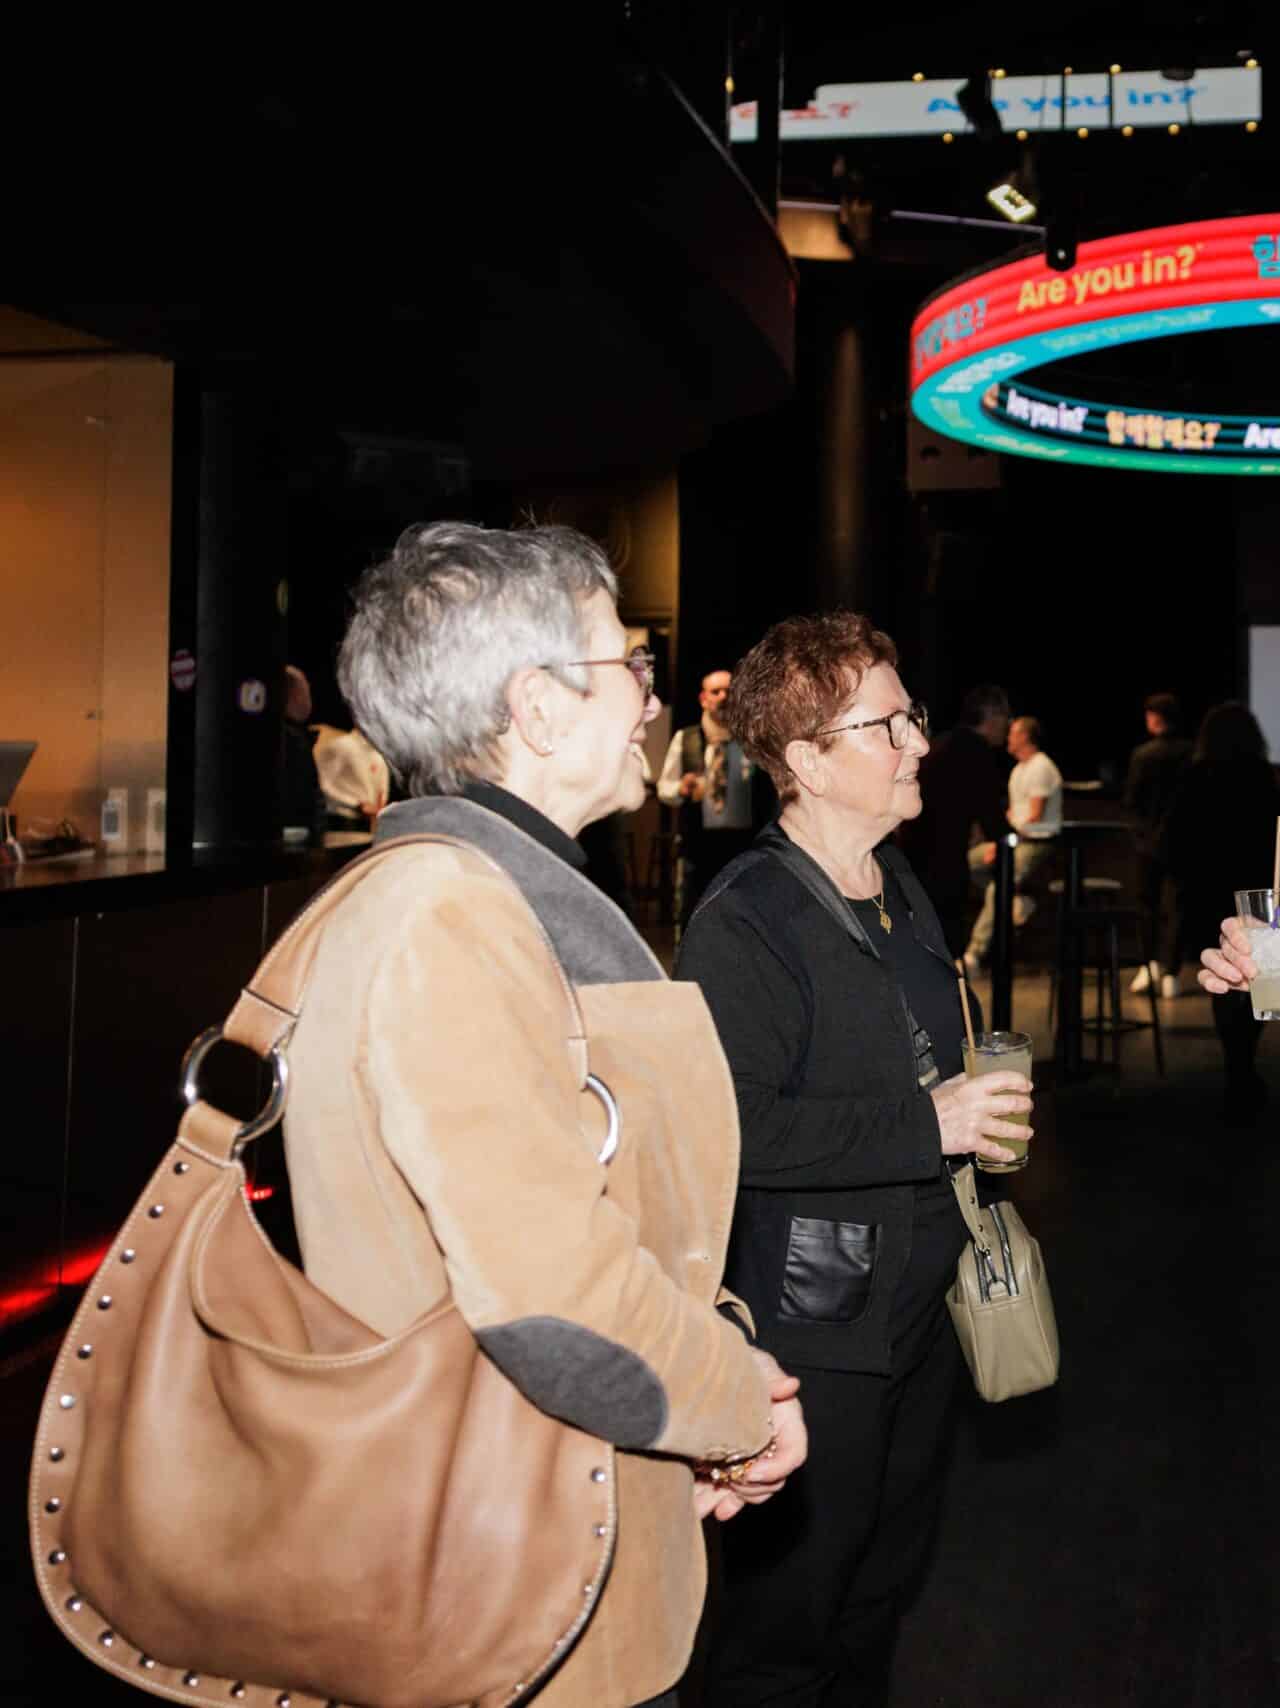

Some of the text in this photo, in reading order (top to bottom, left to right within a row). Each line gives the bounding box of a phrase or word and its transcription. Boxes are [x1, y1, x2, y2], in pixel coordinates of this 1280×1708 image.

[1016, 244, 1202, 313] Are you in?
